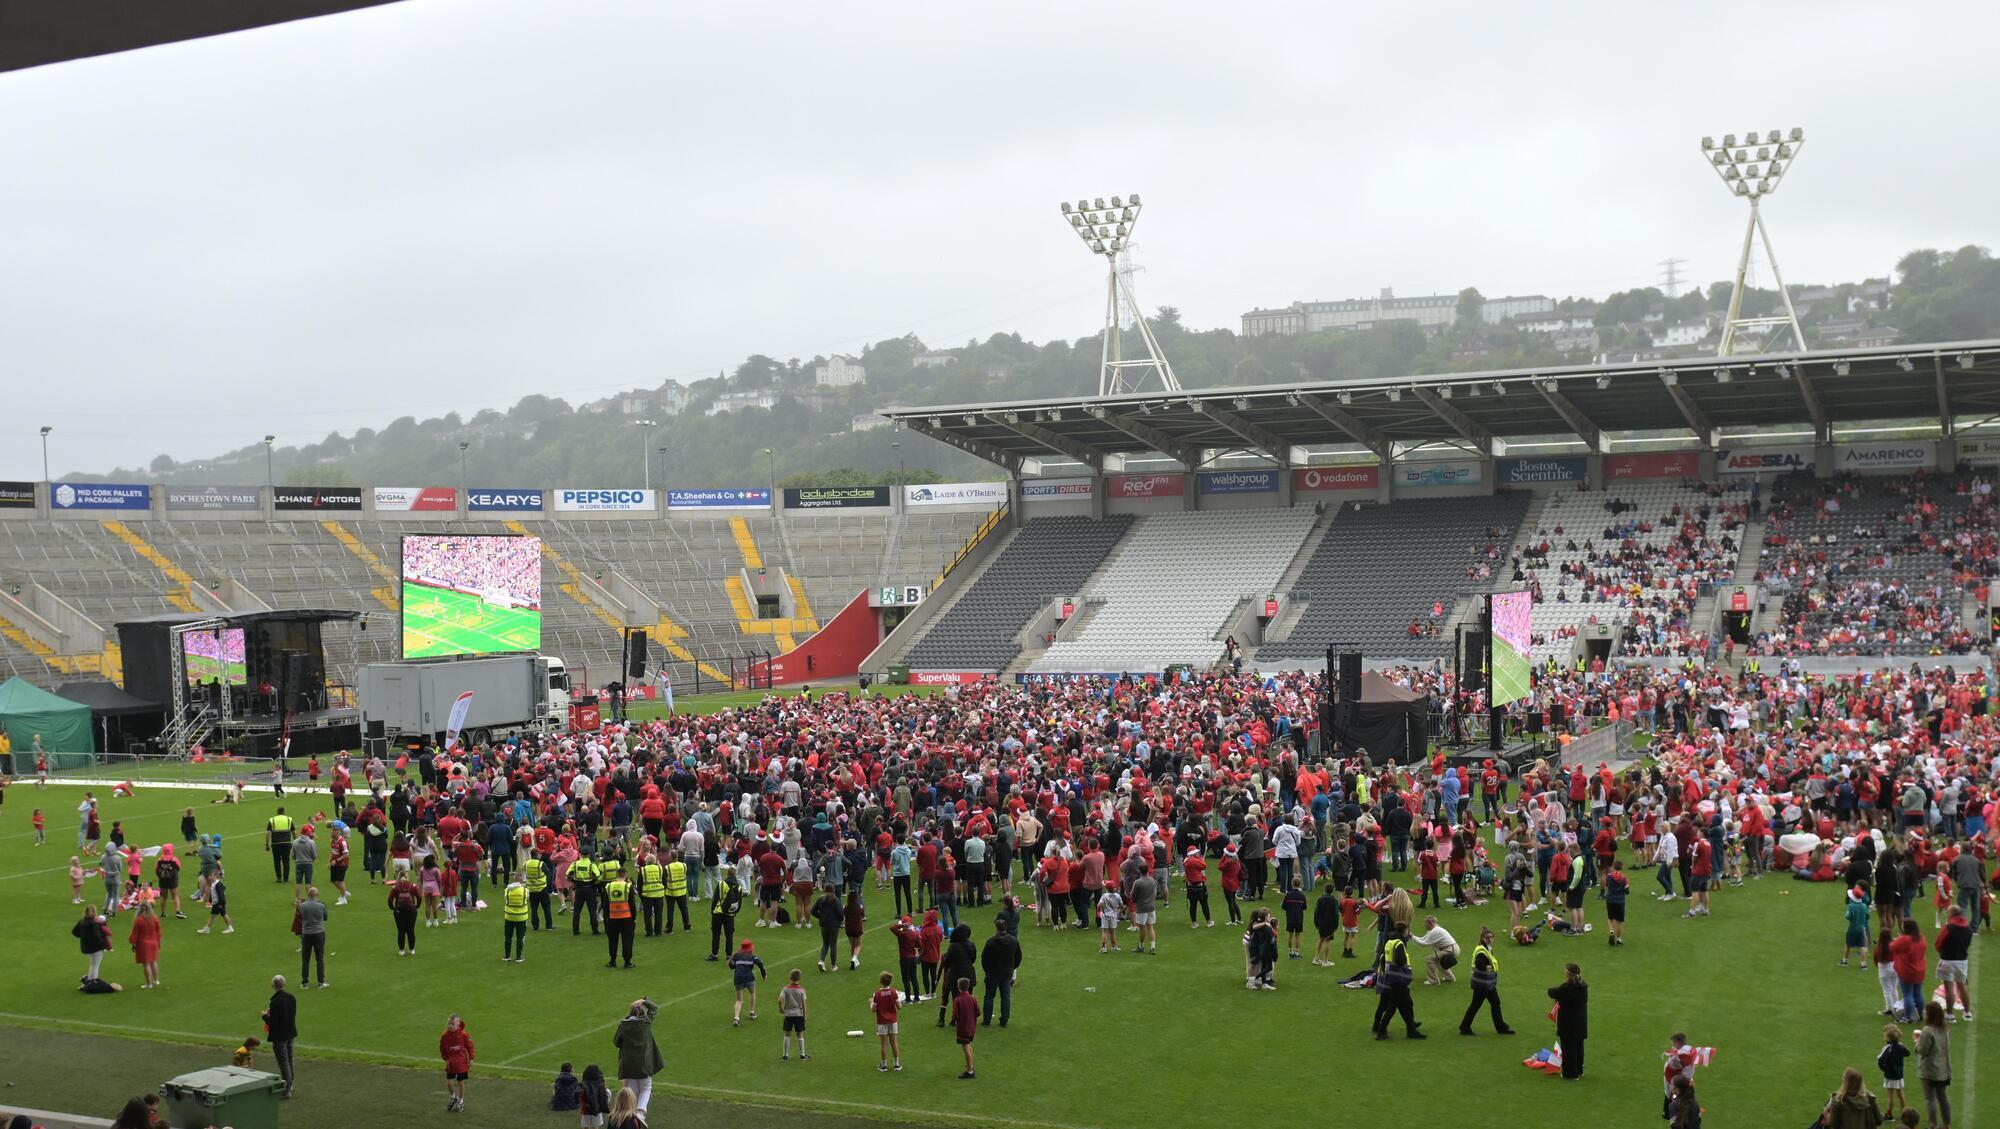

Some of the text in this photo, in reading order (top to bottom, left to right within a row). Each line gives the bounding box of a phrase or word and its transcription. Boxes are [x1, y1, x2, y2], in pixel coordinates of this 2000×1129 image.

[1519, 460, 1558, 472] Boston
[1322, 472, 1369, 483] vodafone
[1511, 465, 1574, 481] Scientific
[1211, 473, 1269, 486] walshgroup
[934, 490, 956, 498] LAIDE
[957, 490, 965, 498] &
[966, 488, 997, 497] O'BRIEN
[1023, 485, 1092, 495] SPORTS DIRECT
[169, 494, 256, 503] ROCHESTOWN PARK
[273, 495, 313, 503] LEHANE
[467, 494, 541, 505] KEARYS
[563, 491, 644, 504] PEPSICO
[906, 588, 919, 603] B
[918, 673, 960, 684] SuperValu
[1487, 776, 1497, 786] 28
[539, 834, 545, 843] 5
